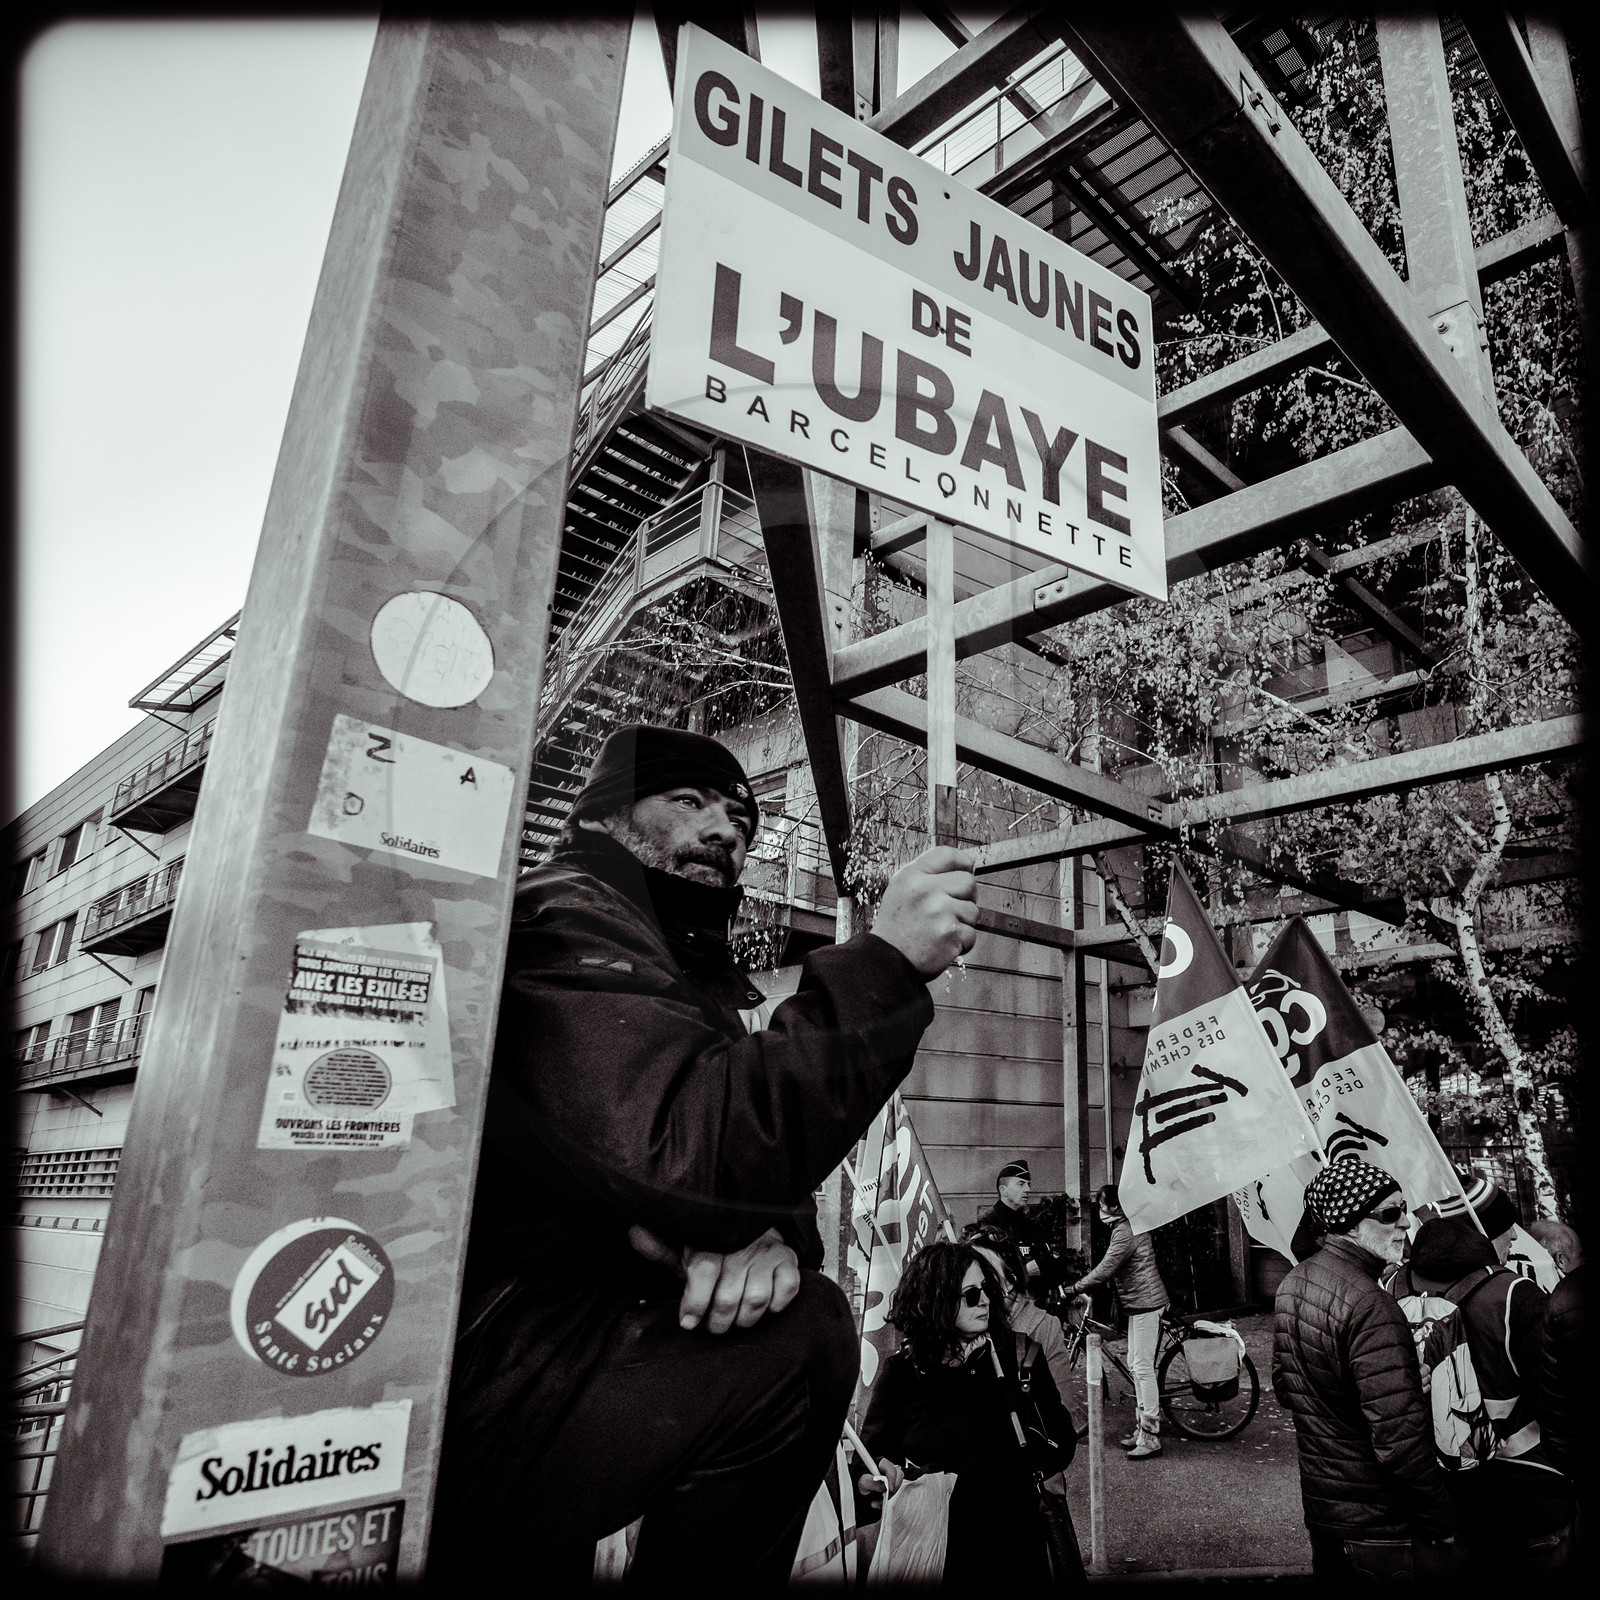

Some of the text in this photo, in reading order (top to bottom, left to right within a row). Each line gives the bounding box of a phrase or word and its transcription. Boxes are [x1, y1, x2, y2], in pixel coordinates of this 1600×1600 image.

[693, 69, 1142, 371] GILETS JAUNES
[911, 287, 972, 358] DE
[704, 374, 1133, 569] BARCELONNETTE
[380, 831, 441, 859] Solidaires
[293, 970, 336, 992] AVEC
[336, 975, 364, 995] LES
[378, 967, 393, 979] LES
[275, 1117, 323, 1131] OUVRONS
[326, 1119, 342, 1131] LES
[255, 1314, 384, 1372] Santé Sociaux
[196, 1438, 382, 1502] Solidaires
[251, 1506, 397, 1567] TOUTES ET
